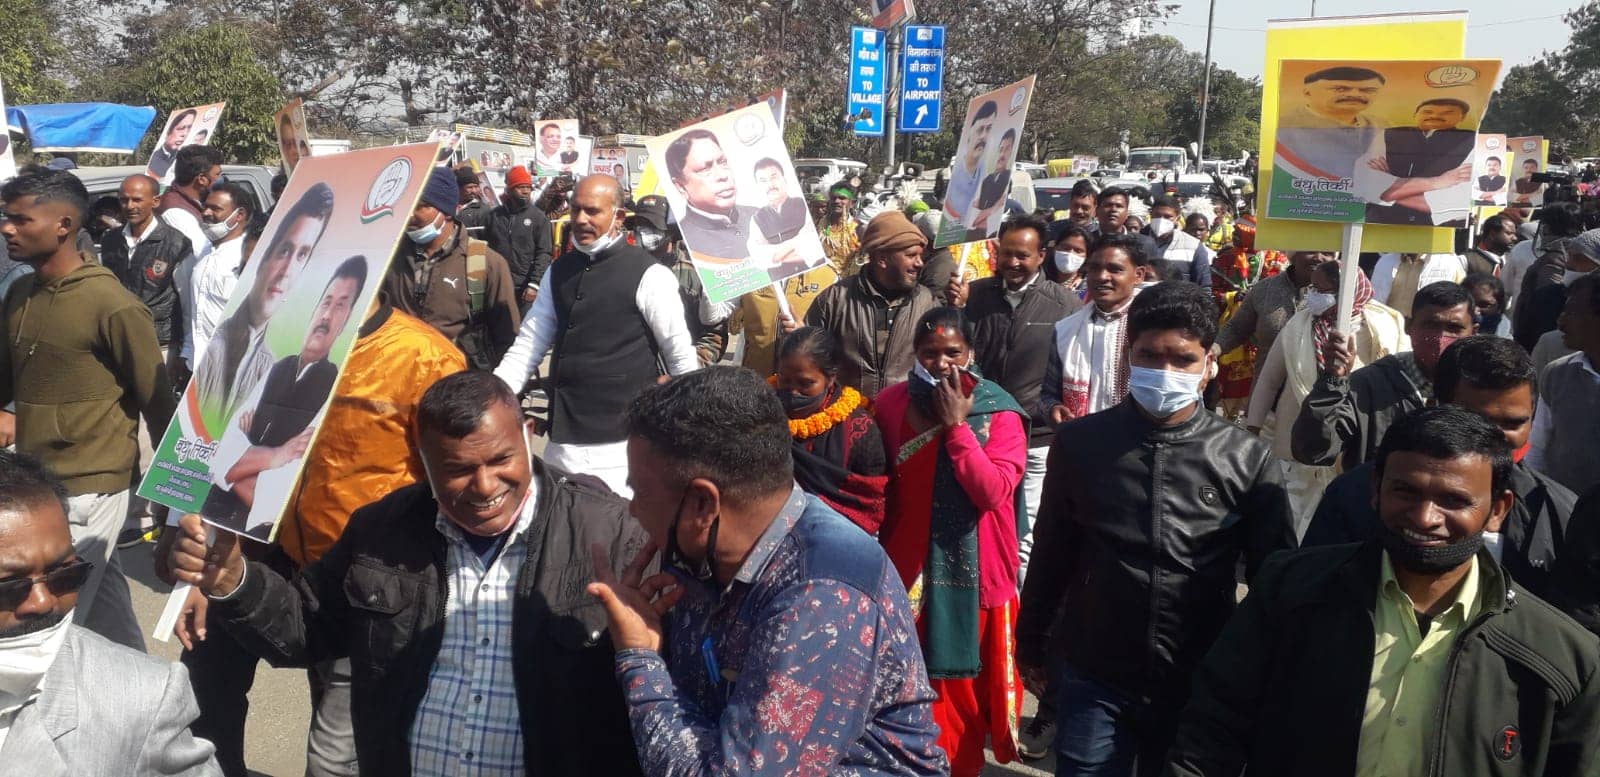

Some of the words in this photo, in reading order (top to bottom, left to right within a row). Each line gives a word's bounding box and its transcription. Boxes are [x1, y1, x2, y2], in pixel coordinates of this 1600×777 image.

[909, 60, 919, 72] की
[920, 63, 936, 73] तरफ
[862, 80, 872, 91] TO
[917, 78, 928, 88] TO
[851, 93, 882, 104] VILLAGE
[905, 90, 940, 100] AIRPORT
